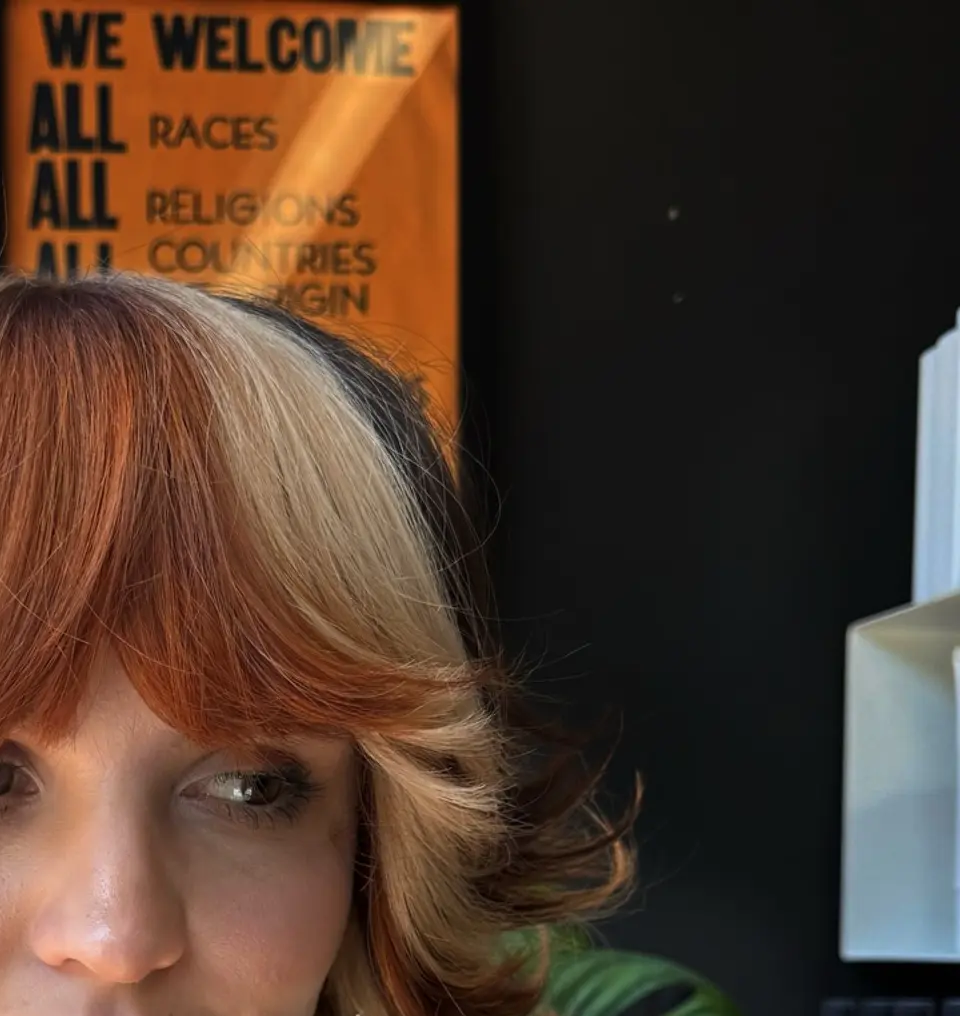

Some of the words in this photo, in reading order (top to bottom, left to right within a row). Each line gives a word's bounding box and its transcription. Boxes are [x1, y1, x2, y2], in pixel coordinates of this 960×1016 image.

[42, 12, 124, 68] WE
[153, 15, 415, 76] WELCOME
[28, 82, 127, 153] ALL
[149, 115, 277, 151] RACES
[28, 159, 118, 230] ALL
[146, 191, 359, 227] RELIGIONS
[148, 238, 376, 276] COUNTRIES
